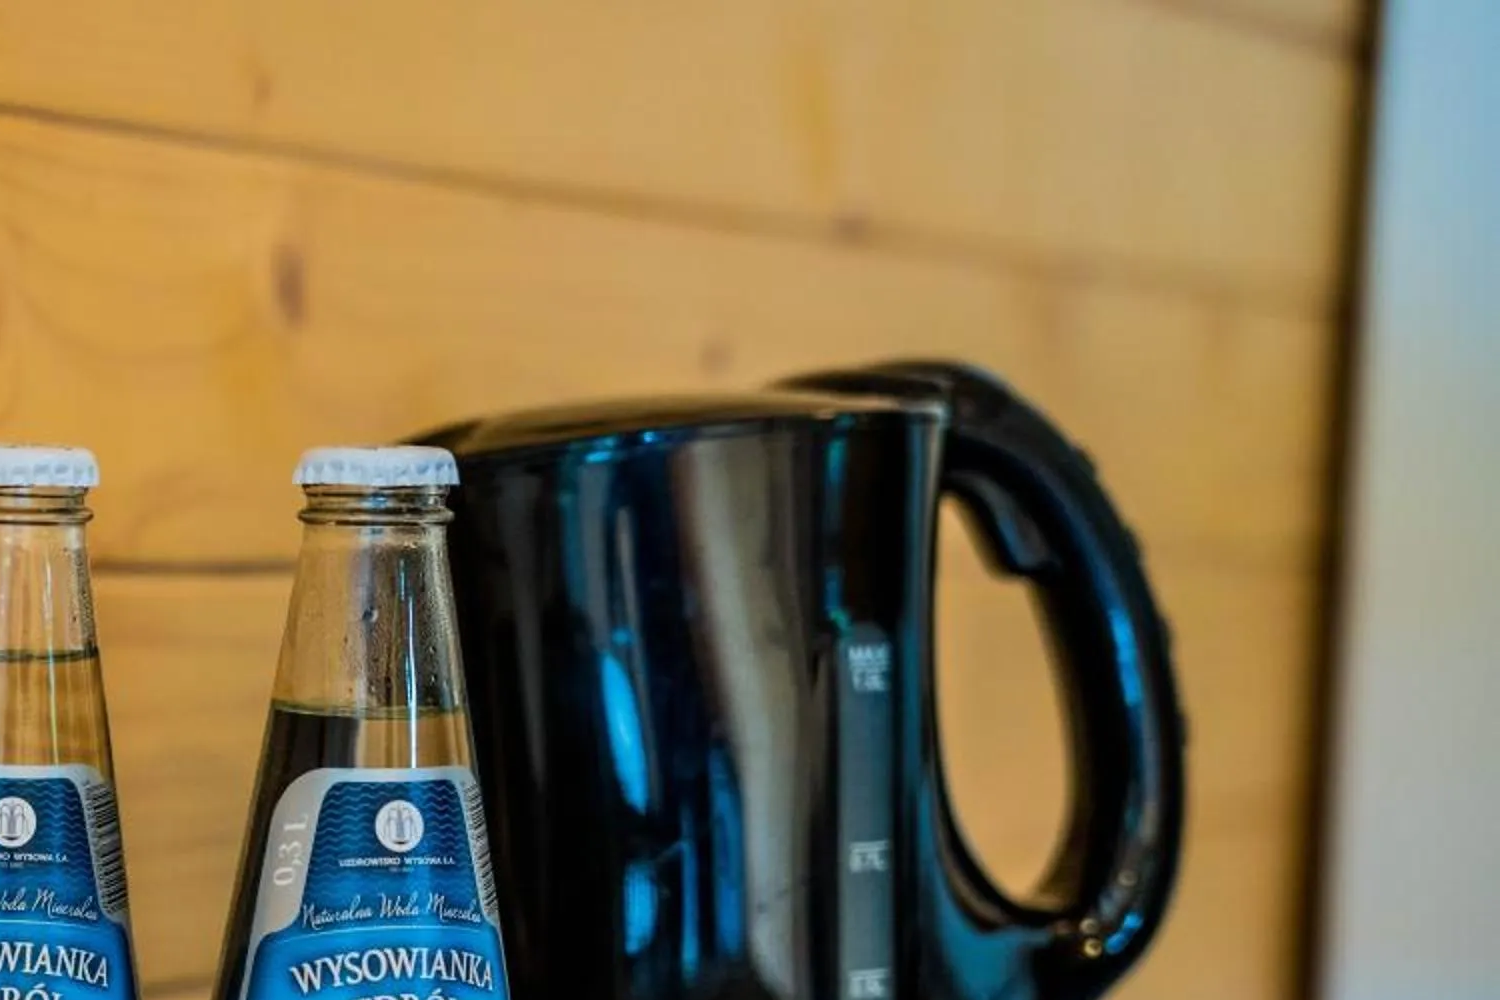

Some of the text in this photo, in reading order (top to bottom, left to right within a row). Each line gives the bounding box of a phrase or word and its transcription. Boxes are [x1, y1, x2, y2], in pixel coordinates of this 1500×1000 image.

[284, 814, 309, 832] L
[302, 893, 373, 930] Naturalna
[378, 892, 420, 919] Woda
[289, 947, 494, 995] WYSOWIANKA
